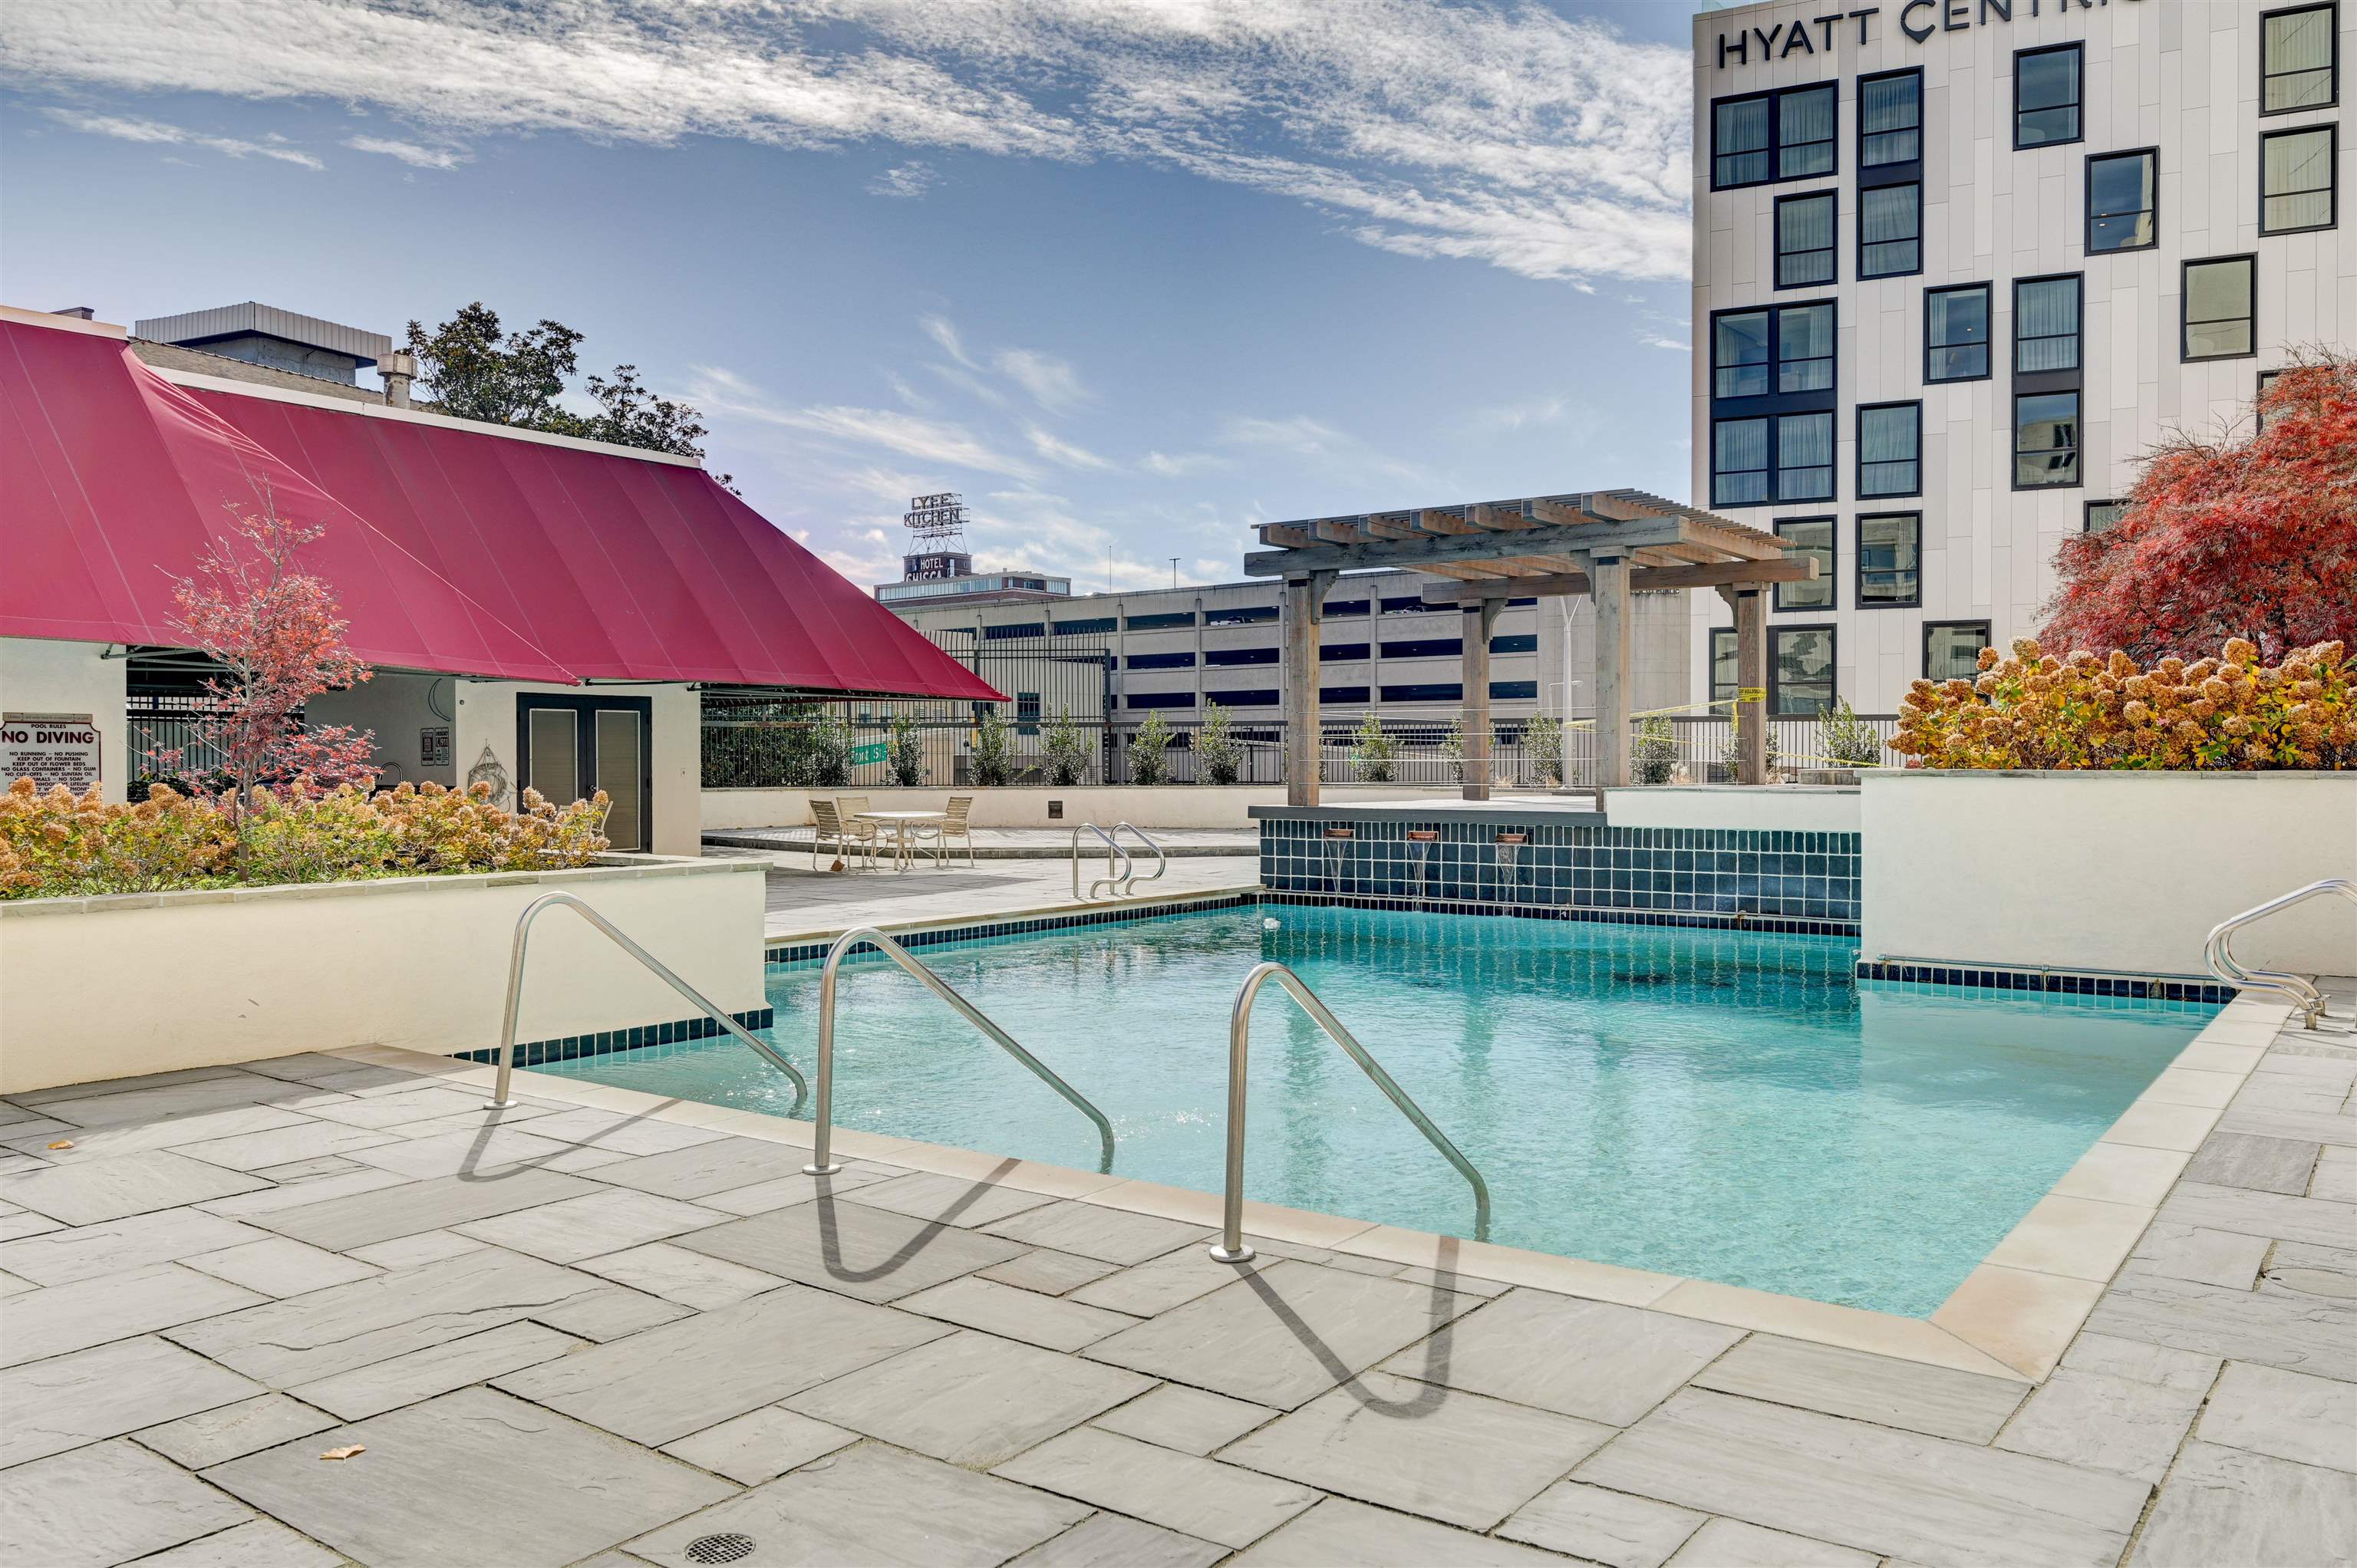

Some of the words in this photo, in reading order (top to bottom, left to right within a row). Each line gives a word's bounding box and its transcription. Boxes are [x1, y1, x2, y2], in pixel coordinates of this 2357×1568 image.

[1719, 7, 1880, 69] HYATT
[904, 507, 960, 525] KITCHEN
[921, 557, 944, 570] HOTEL
[2, 731, 28, 743] NO
[36, 731, 94, 743] DIVING
